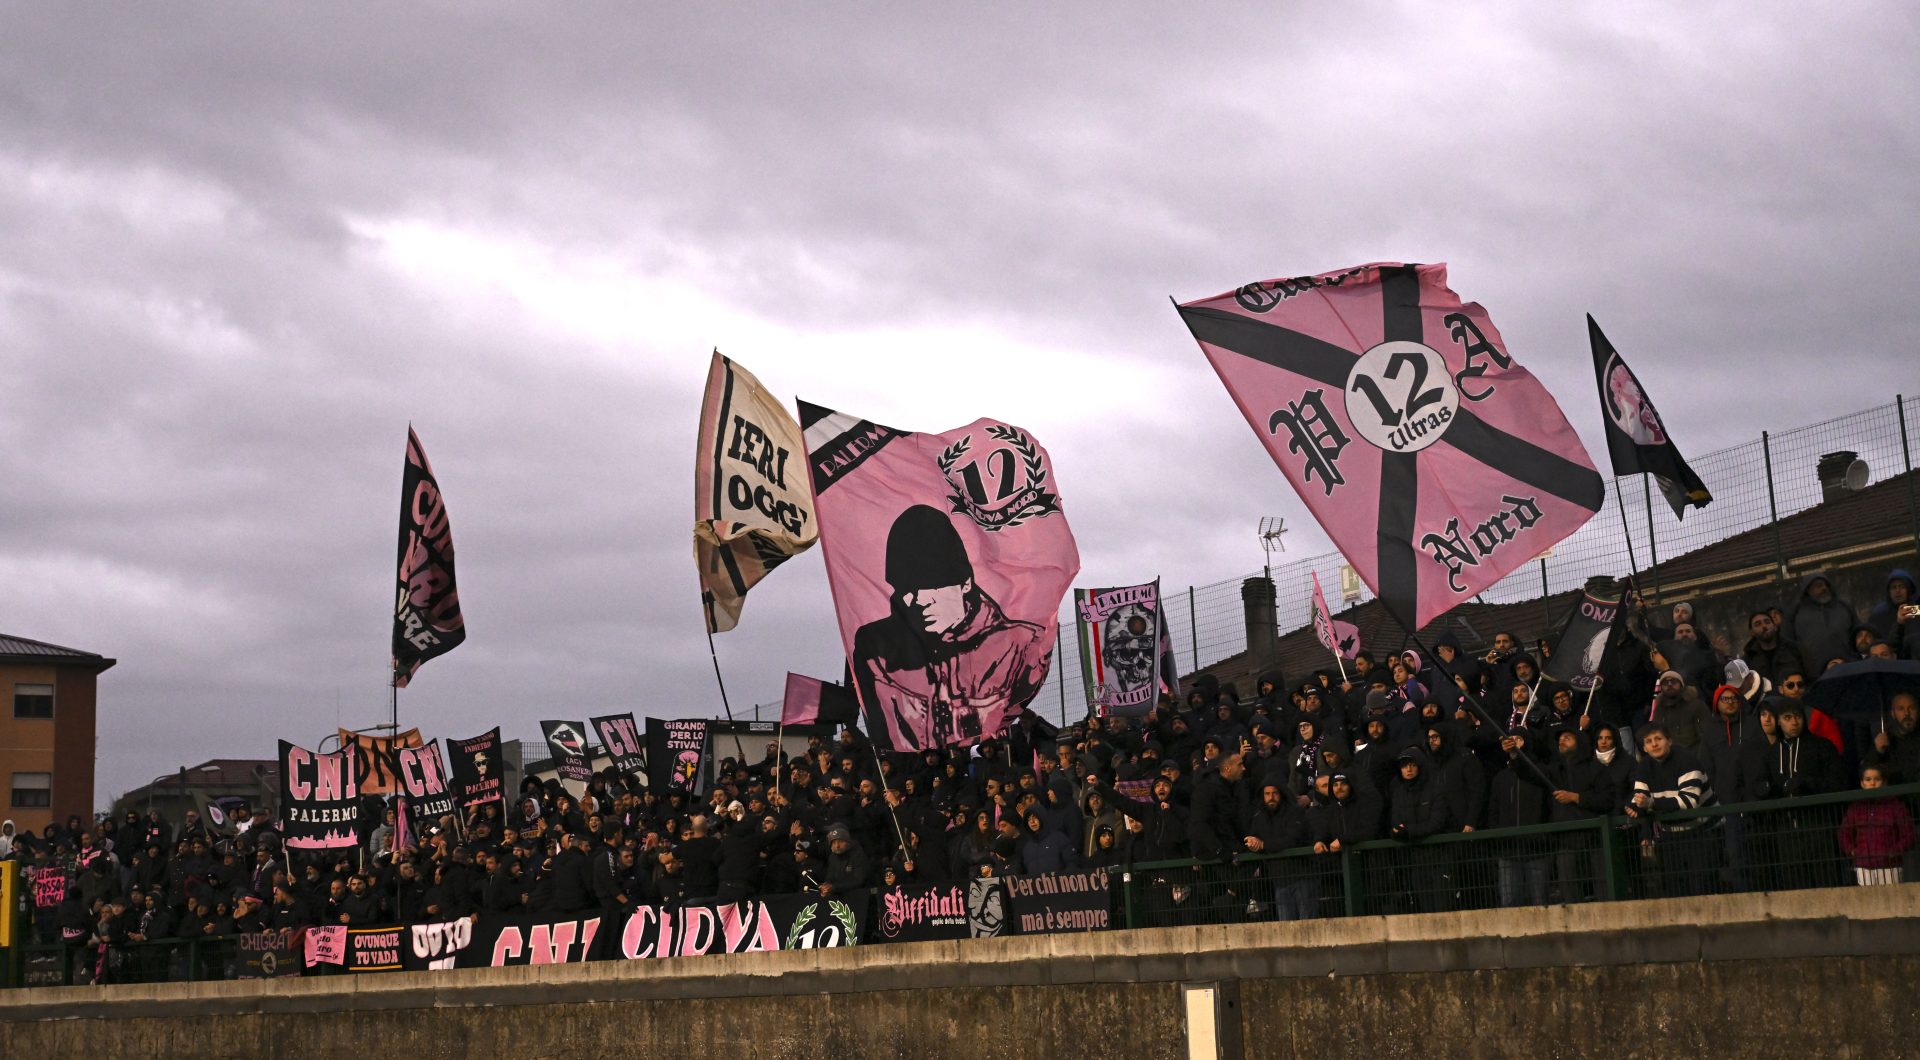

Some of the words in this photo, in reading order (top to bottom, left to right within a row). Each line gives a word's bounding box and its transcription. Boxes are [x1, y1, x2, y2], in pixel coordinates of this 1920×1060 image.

[1442, 312, 1512, 402] A
[1351, 352, 1445, 428] 12
[1388, 405, 1453, 450] Ultras
[727, 414, 790, 491] IERI
[818, 423, 889, 478] PALERM
[956, 447, 1025, 506] 12
[1420, 495, 1545, 594] Nord
[600, 718, 641, 757] CNI
[667, 740, 702, 749] STIVAL
[670, 731, 691, 740] PER
[693, 732, 704, 740] LO
[288, 741, 357, 801] CNI
[400, 743, 448, 797] CNI
[290, 805, 357, 823] PALERMO
[1035, 872, 1058, 895] chi
[1060, 873, 1086, 891] non
[354, 933, 400, 949] OVUNQUE
[1021, 914, 1045, 932] ma
[1046, 907, 1055, 930] è
[1056, 909, 1109, 931] sempre
[356, 951, 370, 965] TU
[371, 950, 399, 964] VADA
